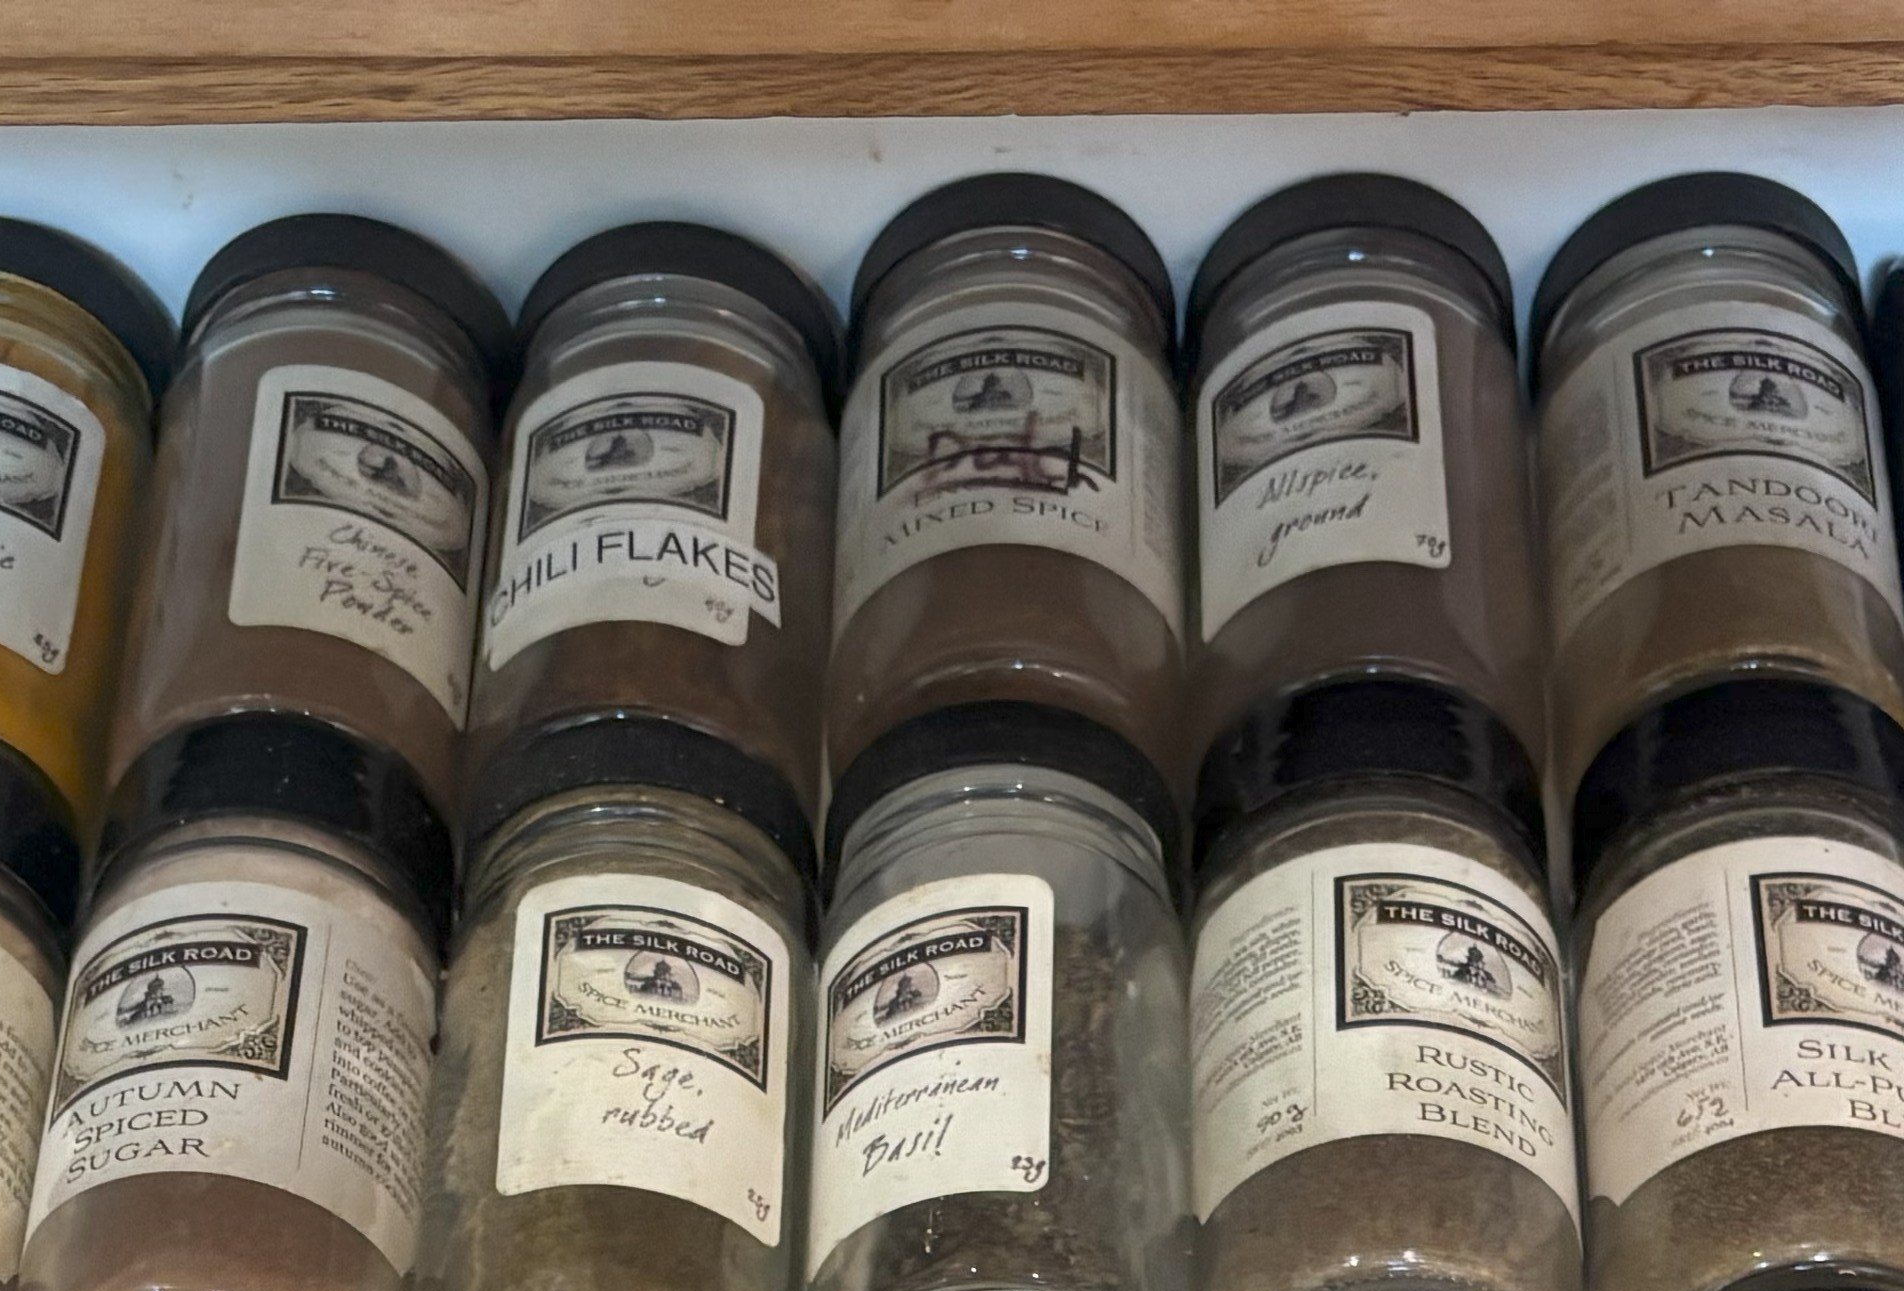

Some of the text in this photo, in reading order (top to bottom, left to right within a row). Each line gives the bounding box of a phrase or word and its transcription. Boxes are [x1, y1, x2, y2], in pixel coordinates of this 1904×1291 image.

[1257, 493, 1370, 568] ground
[1678, 505, 1870, 559] MASALA
[490, 531, 777, 627] CHILI FLAKES
[1415, 1045, 1536, 1106] RUSTIC
[62, 1080, 240, 1139] AUTUMN
[72, 1109, 209, 1157] SPICED
[602, 1099, 716, 1145] rubbed
[1384, 1072, 1556, 1149] ROASTING
[1416, 1103, 1538, 1158] BLEND
[66, 1138, 211, 1185] SUGAR
[862, 1113, 956, 1178] Basil
